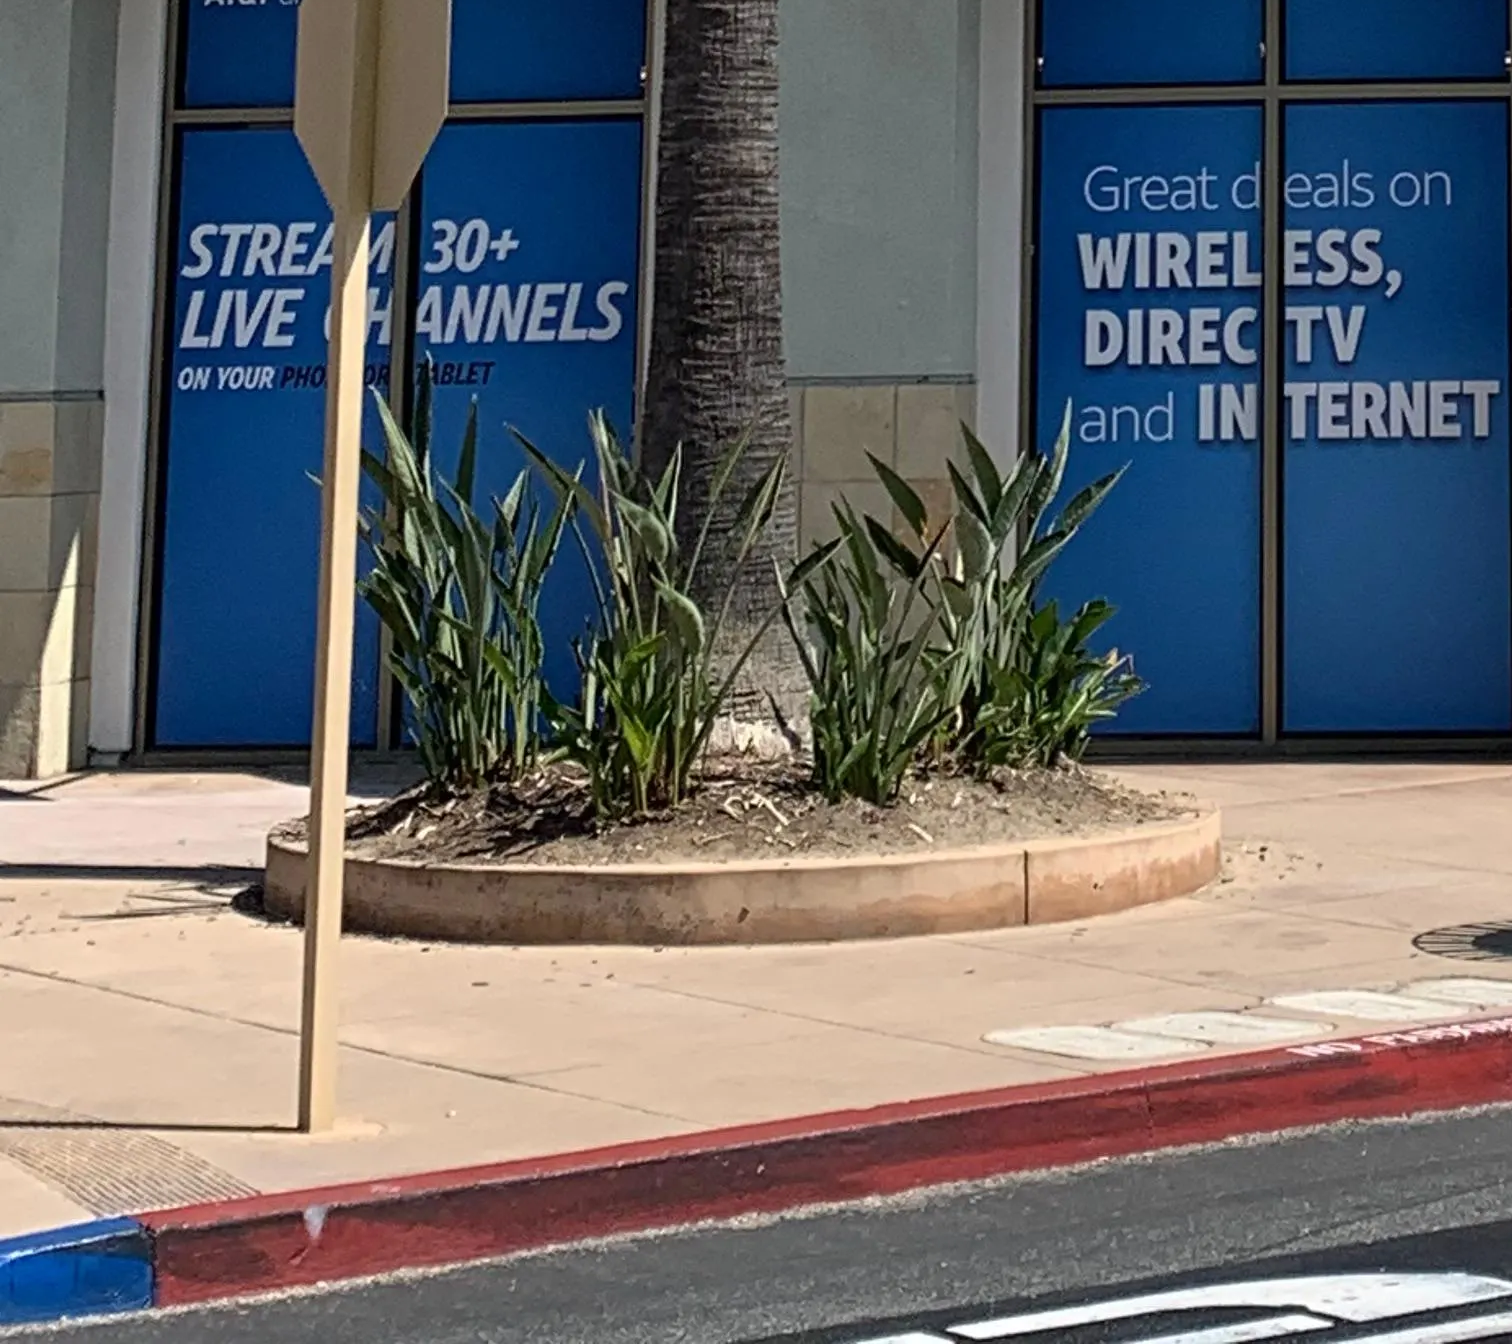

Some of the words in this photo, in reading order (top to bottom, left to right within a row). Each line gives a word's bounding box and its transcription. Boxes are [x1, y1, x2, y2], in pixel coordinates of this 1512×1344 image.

[1084, 165, 1219, 212] Great
[1231, 160, 1375, 209] deals
[1389, 171, 1451, 208] on
[424, 218, 520, 275] 30+
[1077, 228, 1402, 298] WIRELESS,
[180, 288, 305, 349] LIVE
[324, 281, 629, 348] HANNELS
[1085, 306, 1367, 367] DIRECTV
[177, 367, 211, 390] ON
[216, 366, 277, 390] YOUR
[1079, 391, 1174, 443] and
[1198, 380, 1500, 441] INTERNET
